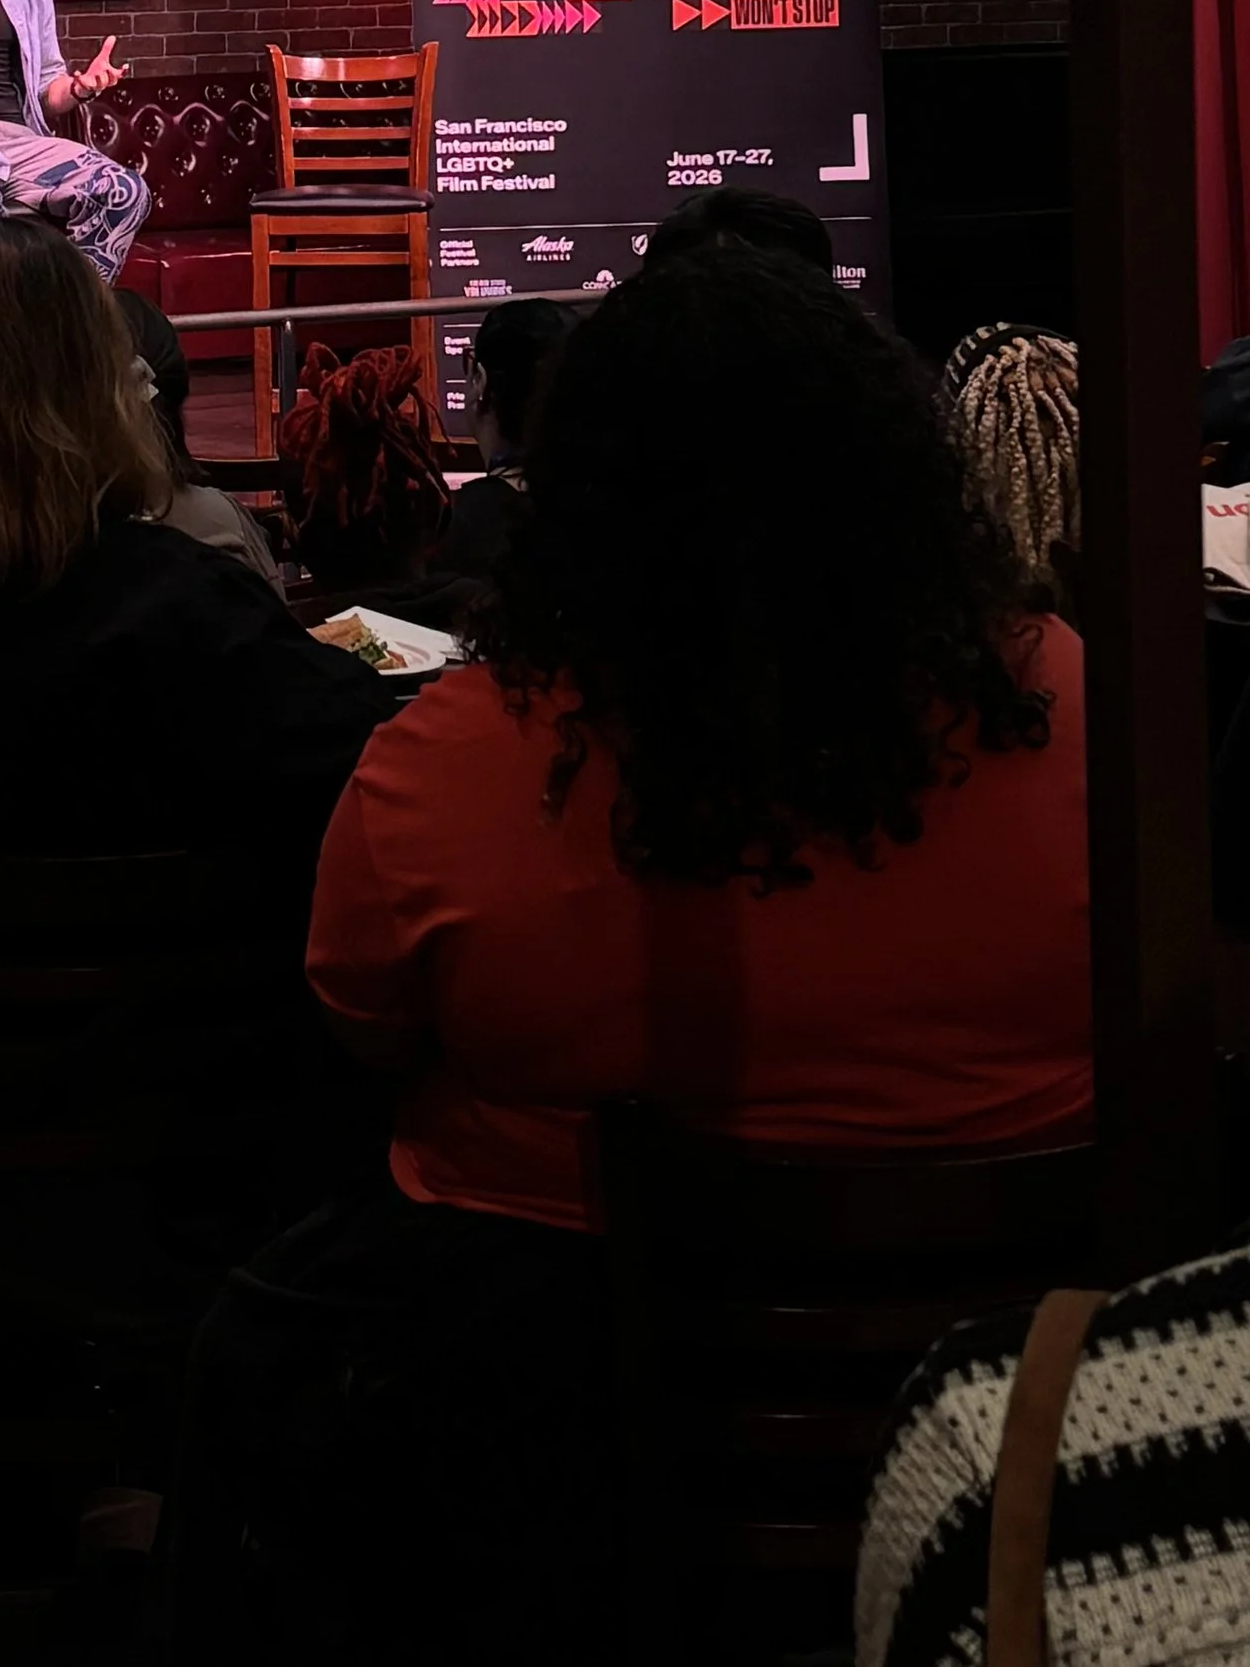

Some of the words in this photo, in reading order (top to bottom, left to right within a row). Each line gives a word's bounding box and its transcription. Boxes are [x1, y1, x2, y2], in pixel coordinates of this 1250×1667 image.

[434, 119, 472, 135] San
[474, 117, 567, 134] Francisco
[435, 136, 555, 154] International
[436, 156, 515, 173] LGBTQ+
[666, 150, 714, 167] June
[437, 176, 479, 192] Film
[480, 174, 556, 191] Festival
[667, 169, 723, 186] 2026
[521, 235, 574, 253] Alaska
